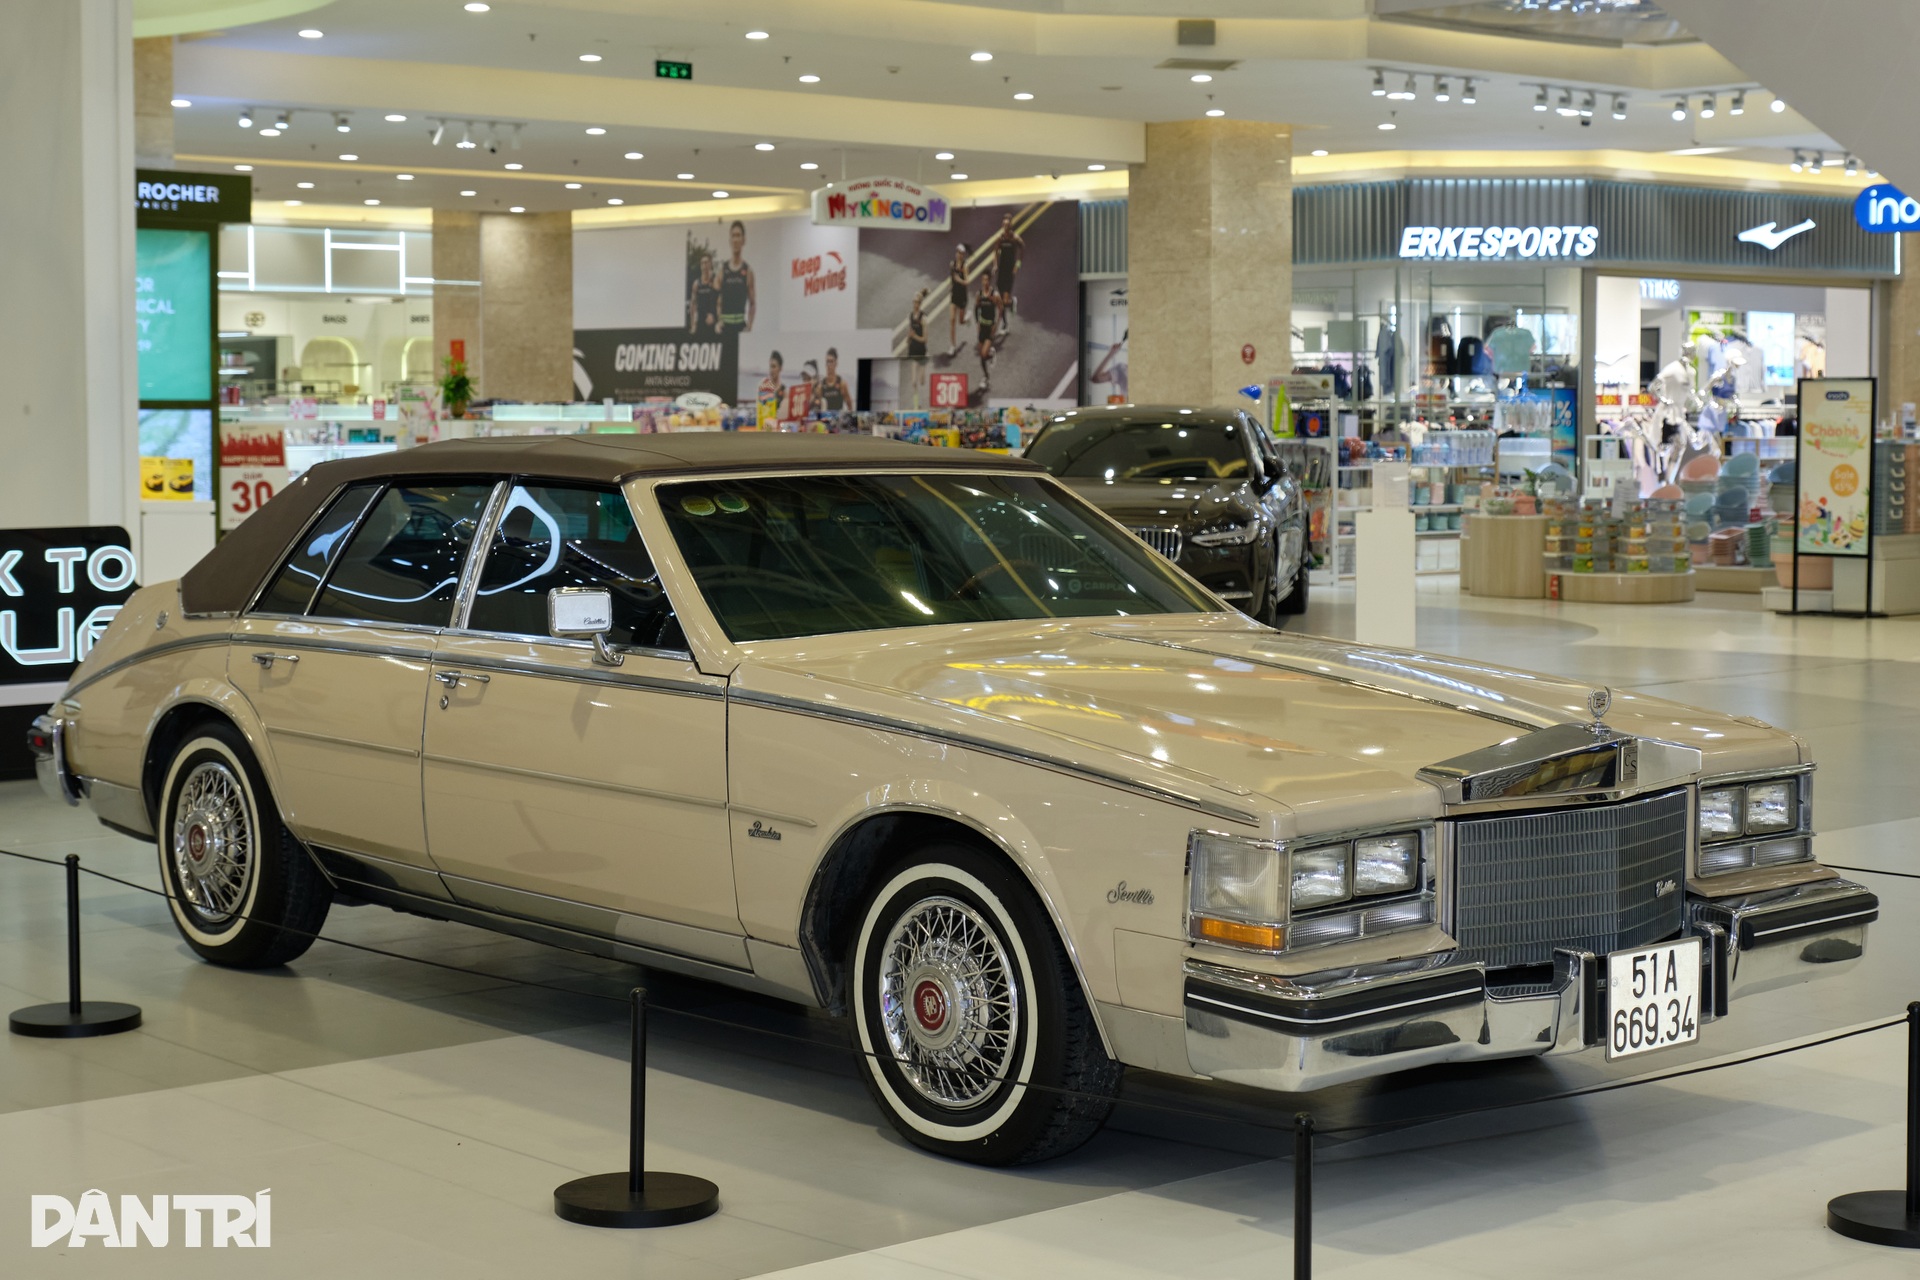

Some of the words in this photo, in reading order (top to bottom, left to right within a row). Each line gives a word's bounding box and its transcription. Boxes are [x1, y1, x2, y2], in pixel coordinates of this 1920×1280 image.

[138, 181, 220, 203] ROCHER
[1868, 188, 1920, 225] ino
[1399, 226, 1599, 257] ERKESPORTS
[615, 342, 677, 372] COMING
[678, 342, 722, 371] SOON
[45, 544, 137, 592] TO
[1106, 880, 1155, 905] Seville
[1632, 949, 1678, 999] 51A
[1613, 994, 1695, 1053] 669.34
